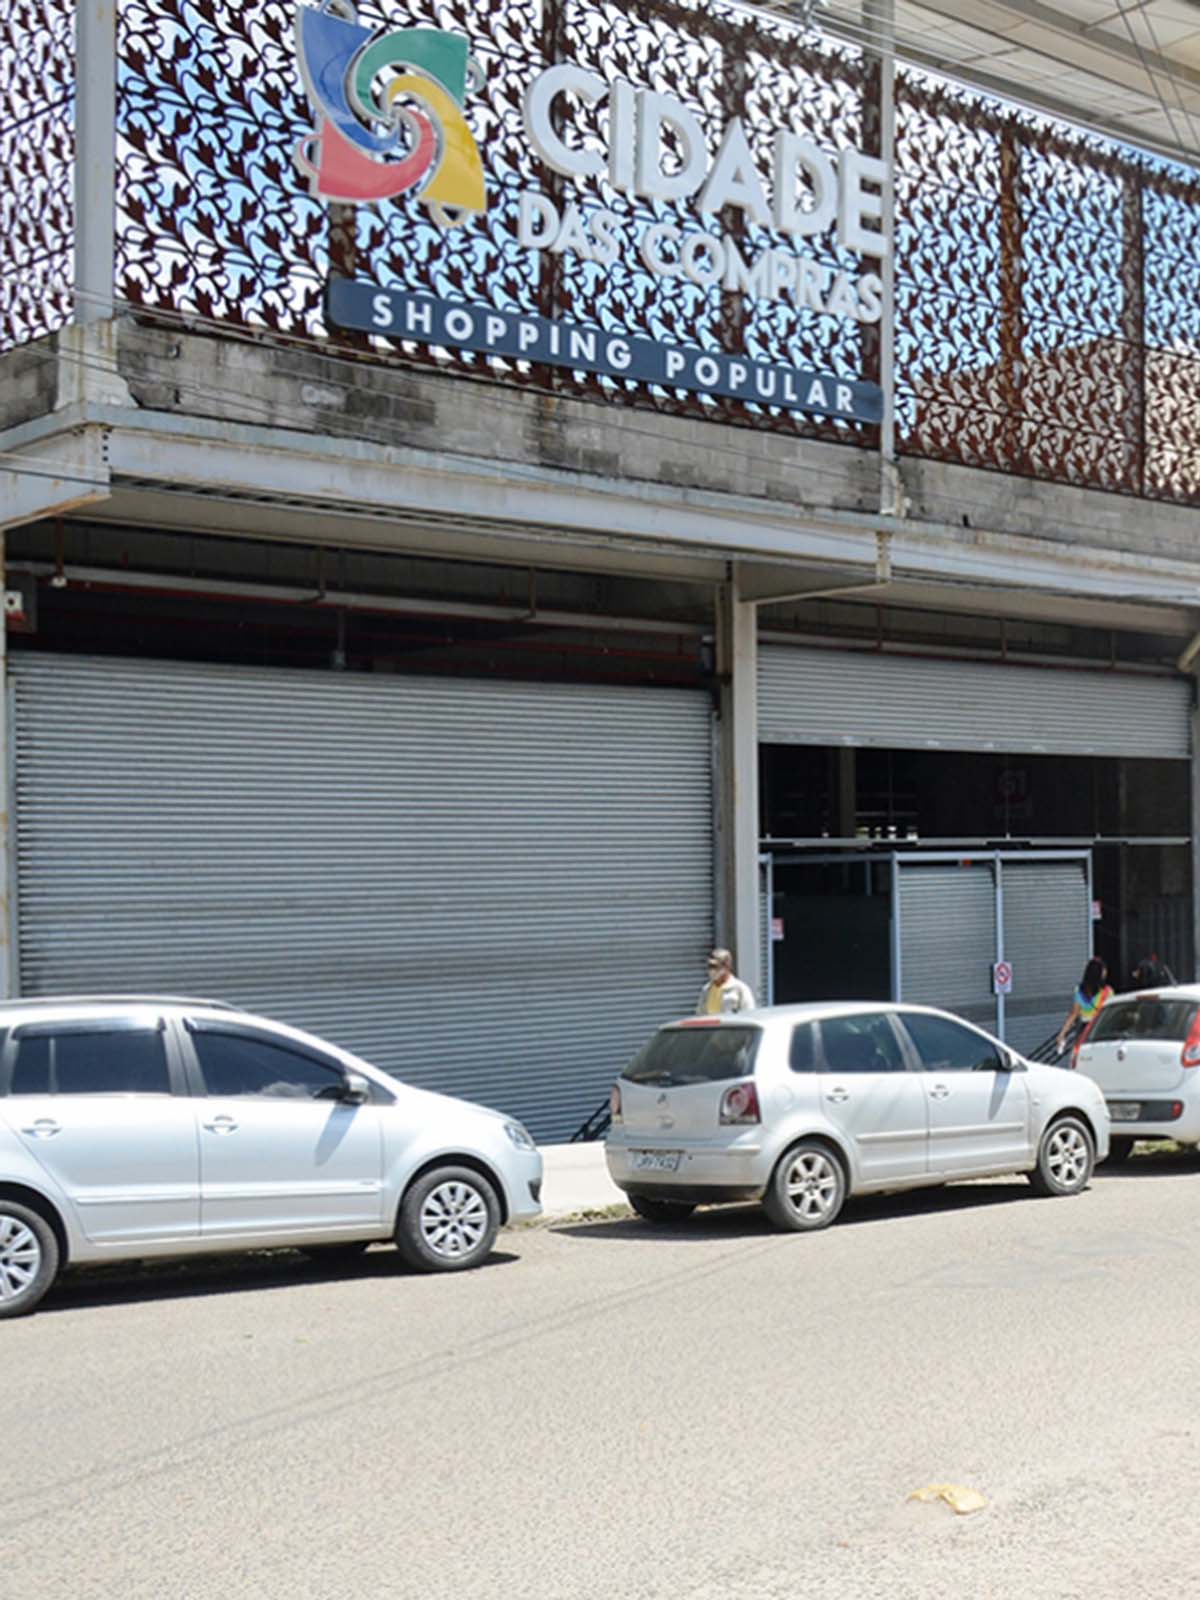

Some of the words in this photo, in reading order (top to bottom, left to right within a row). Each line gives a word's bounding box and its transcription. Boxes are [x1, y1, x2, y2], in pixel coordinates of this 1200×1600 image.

[521, 63, 887, 257] CIDADE
[518, 190, 622, 263] DAS
[641, 223, 884, 323] COMPRAS
[373, 296, 632, 370] SHOPPING
[665, 349, 854, 412] POPULAR
